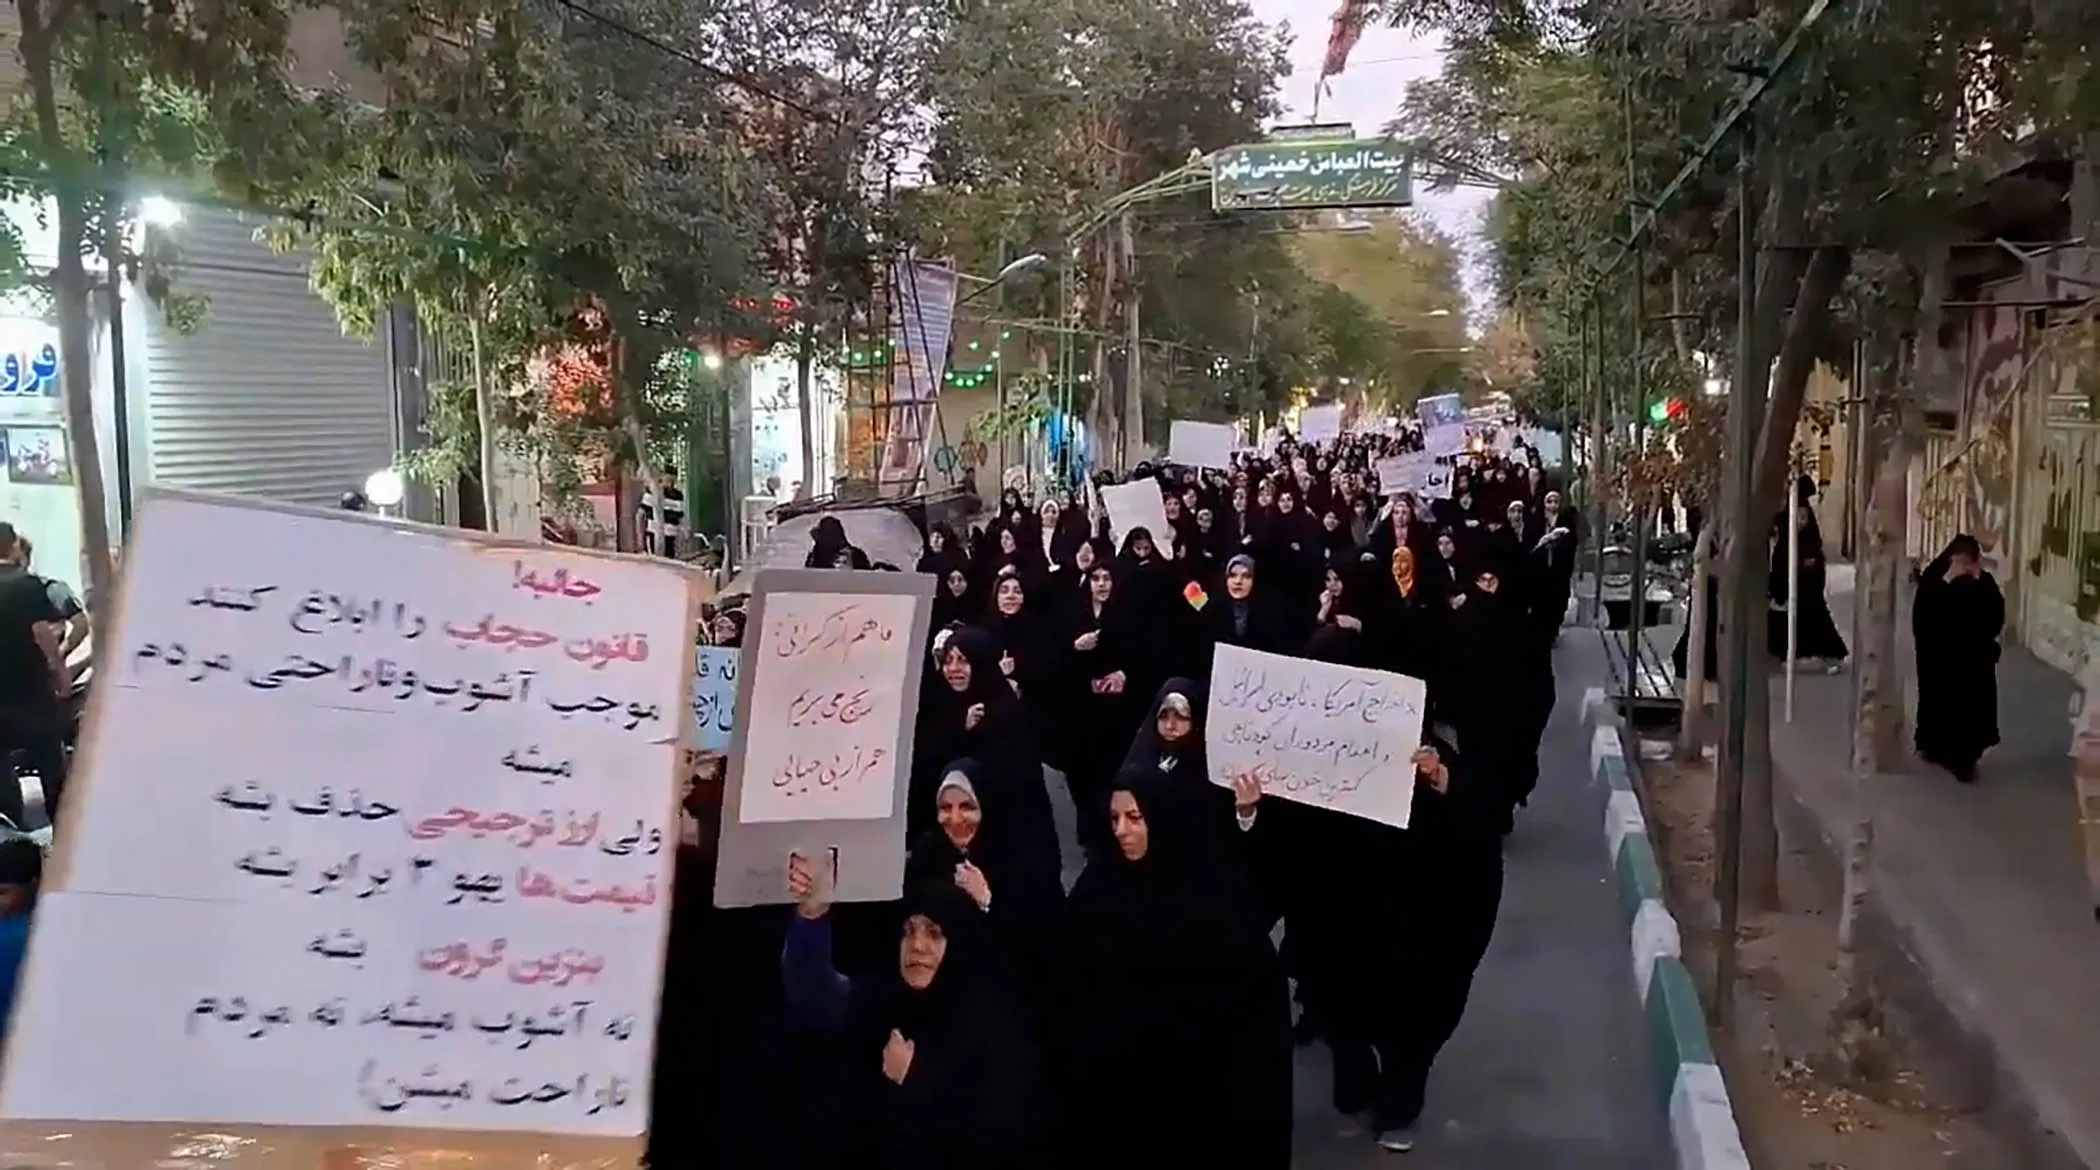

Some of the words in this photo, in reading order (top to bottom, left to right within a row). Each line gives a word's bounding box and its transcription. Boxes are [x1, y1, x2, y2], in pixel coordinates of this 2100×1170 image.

[1217, 151, 1251, 181] شهر
[1251, 151, 1310, 178] خمینی
[1310, 150, 1369, 175] العباس
[1369, 151, 1405, 174] بیت
[0, 344, 57, 392] فرو
[290, 589, 380, 635] ابلاغ
[393, 602, 426, 638] را
[444, 614, 558, 650] حجاب
[134, 643, 232, 681] مردم
[564, 631, 649, 670] قانون
[424, 669, 538, 712] آشوب
[786, 688, 825, 729] بریم
[839, 674, 873, 724] رنج
[546, 695, 661, 730] موجب
[501, 744, 572, 785] میشه
[1333, 740, 1379, 766] اعدام
[212, 780, 272, 821] بشه
[291, 785, 399, 820] حذف
[601, 819, 662, 855] ولی
[234, 847, 298, 888] بشه
[306, 852, 394, 899] برابر
[306, 928, 369, 970] بشه
[419, 937, 509, 980] گرون
[508, 947, 605, 987] بنزین
[185, 997, 292, 1040] مردم
[309, 997, 346, 1027] نه
[472, 1000, 595, 1051] آشوب
[604, 1014, 637, 1041] نه
[488, 1072, 631, 1116] ناراحت
